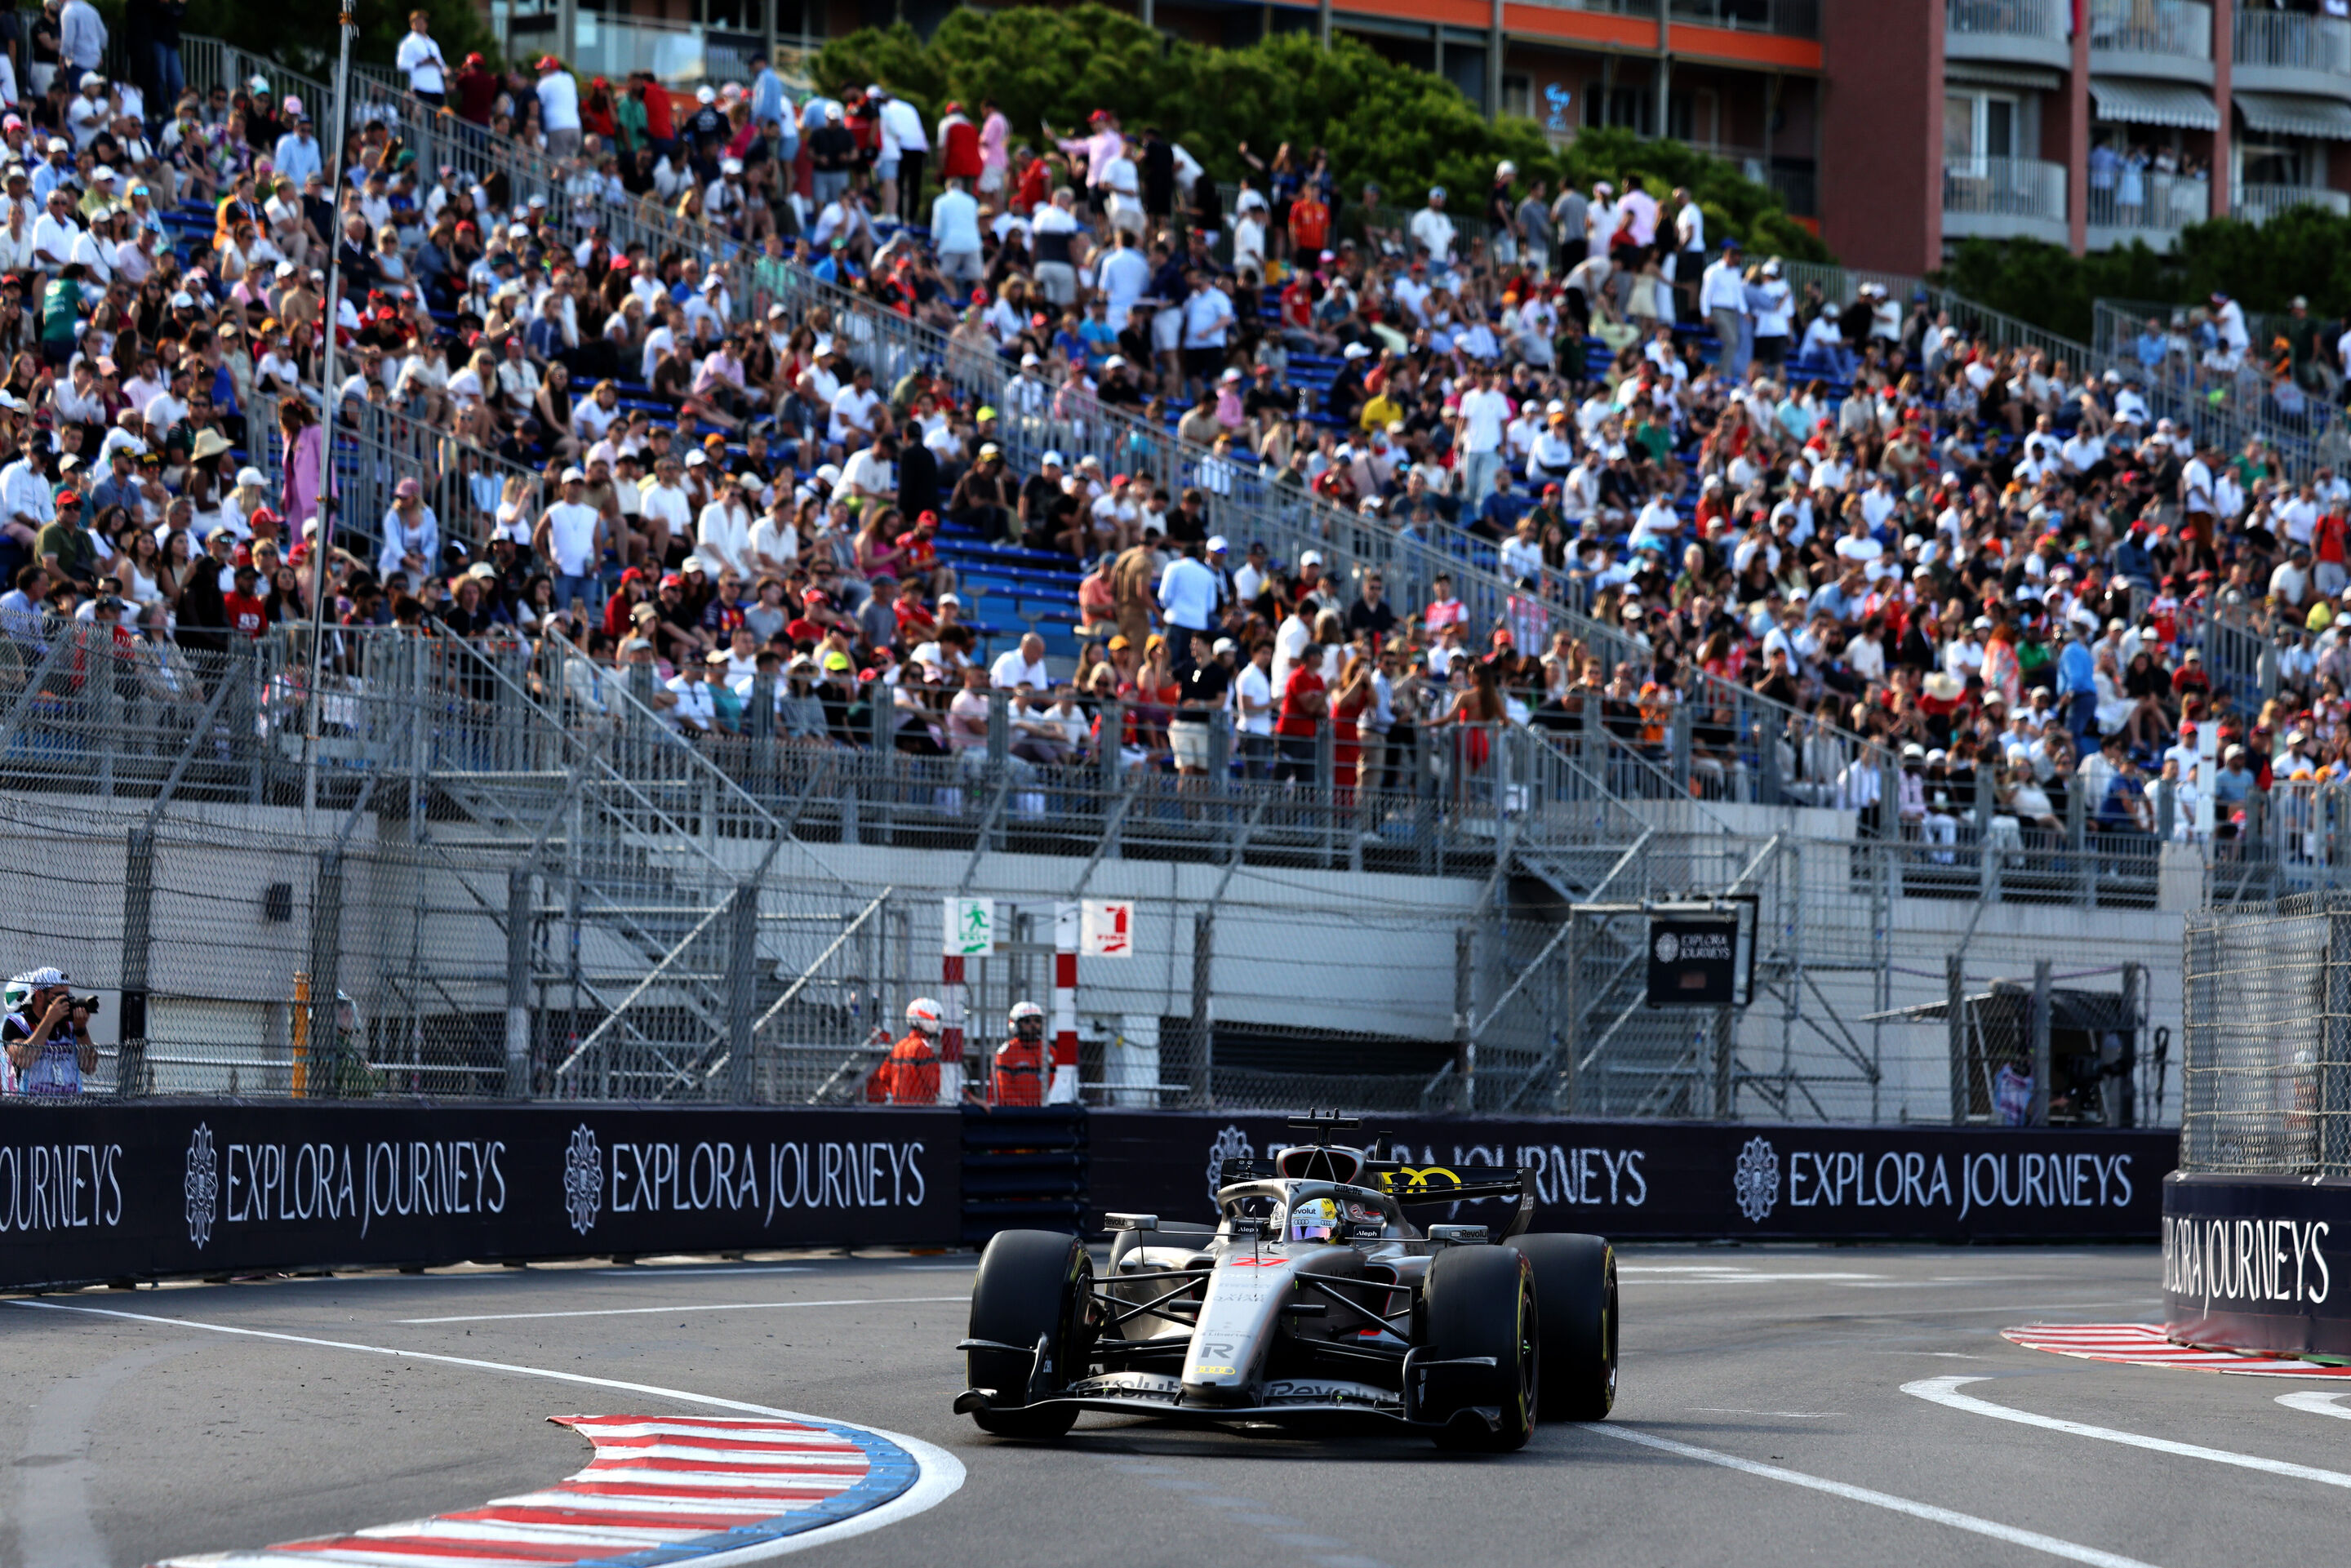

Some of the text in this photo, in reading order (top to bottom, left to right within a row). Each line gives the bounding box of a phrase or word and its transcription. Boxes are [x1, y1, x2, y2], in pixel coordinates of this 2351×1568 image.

[0, 1144, 122, 1233] OURNEYS
[227, 1141, 506, 1239] EXPLORA JOURNEYS
[612, 1142, 925, 1227] EXPLORA JOURNEYS
[1333, 1184, 1363, 1196] Gillette
[1789, 1150, 2132, 1220] EXPLORA JOURNEYS
[1104, 1216, 1126, 1227] Revolut
[1356, 1229, 1378, 1237] Aleph
[1461, 1228, 1489, 1239] Revolut
[1230, 1257, 1291, 1267] 27
[2162, 1216, 2330, 1321] PLORA JOURNEYS
